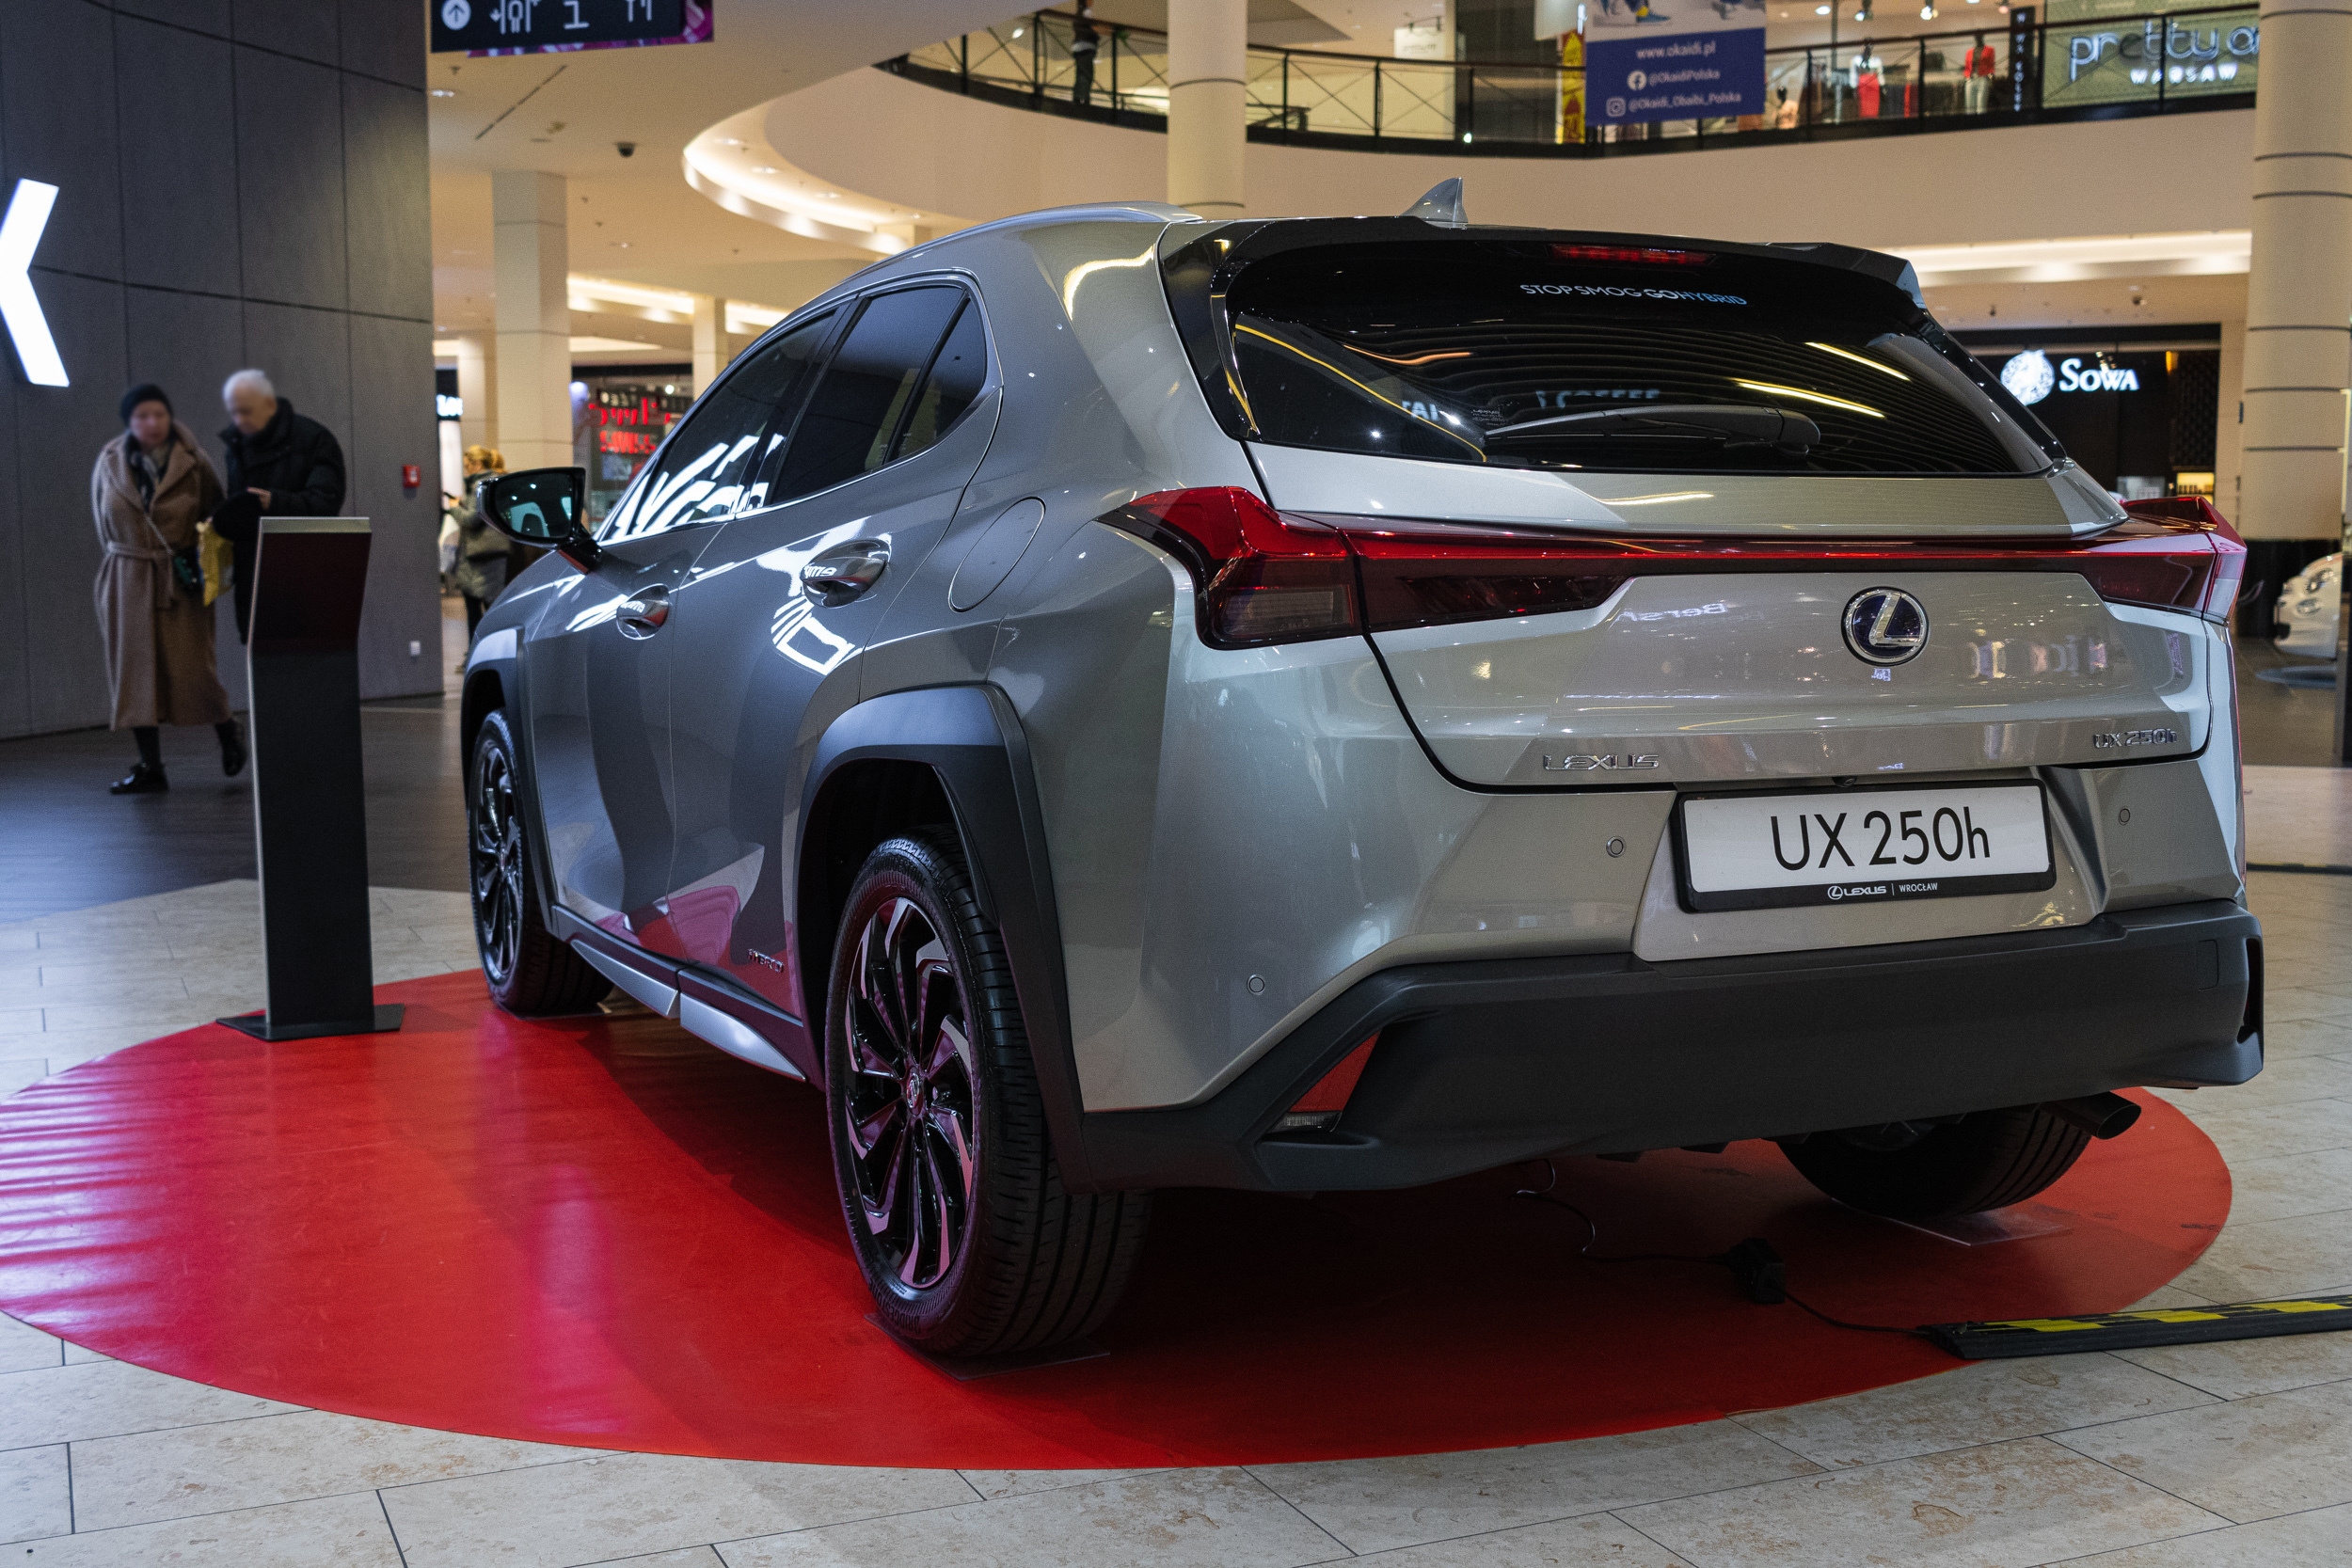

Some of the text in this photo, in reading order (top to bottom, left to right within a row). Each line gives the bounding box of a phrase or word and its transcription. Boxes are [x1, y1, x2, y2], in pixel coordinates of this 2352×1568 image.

[1520, 284, 1574, 294] STOP
[1574, 285, 1643, 297] SMOG
[2093, 728, 2178, 749] UX 250h
[1543, 754, 1660, 770] LEXUS
[1771, 806, 1991, 871] UX 250h
[1844, 885, 1886, 896] LEXUS
[1899, 882, 1938, 893] WROCŁAW
